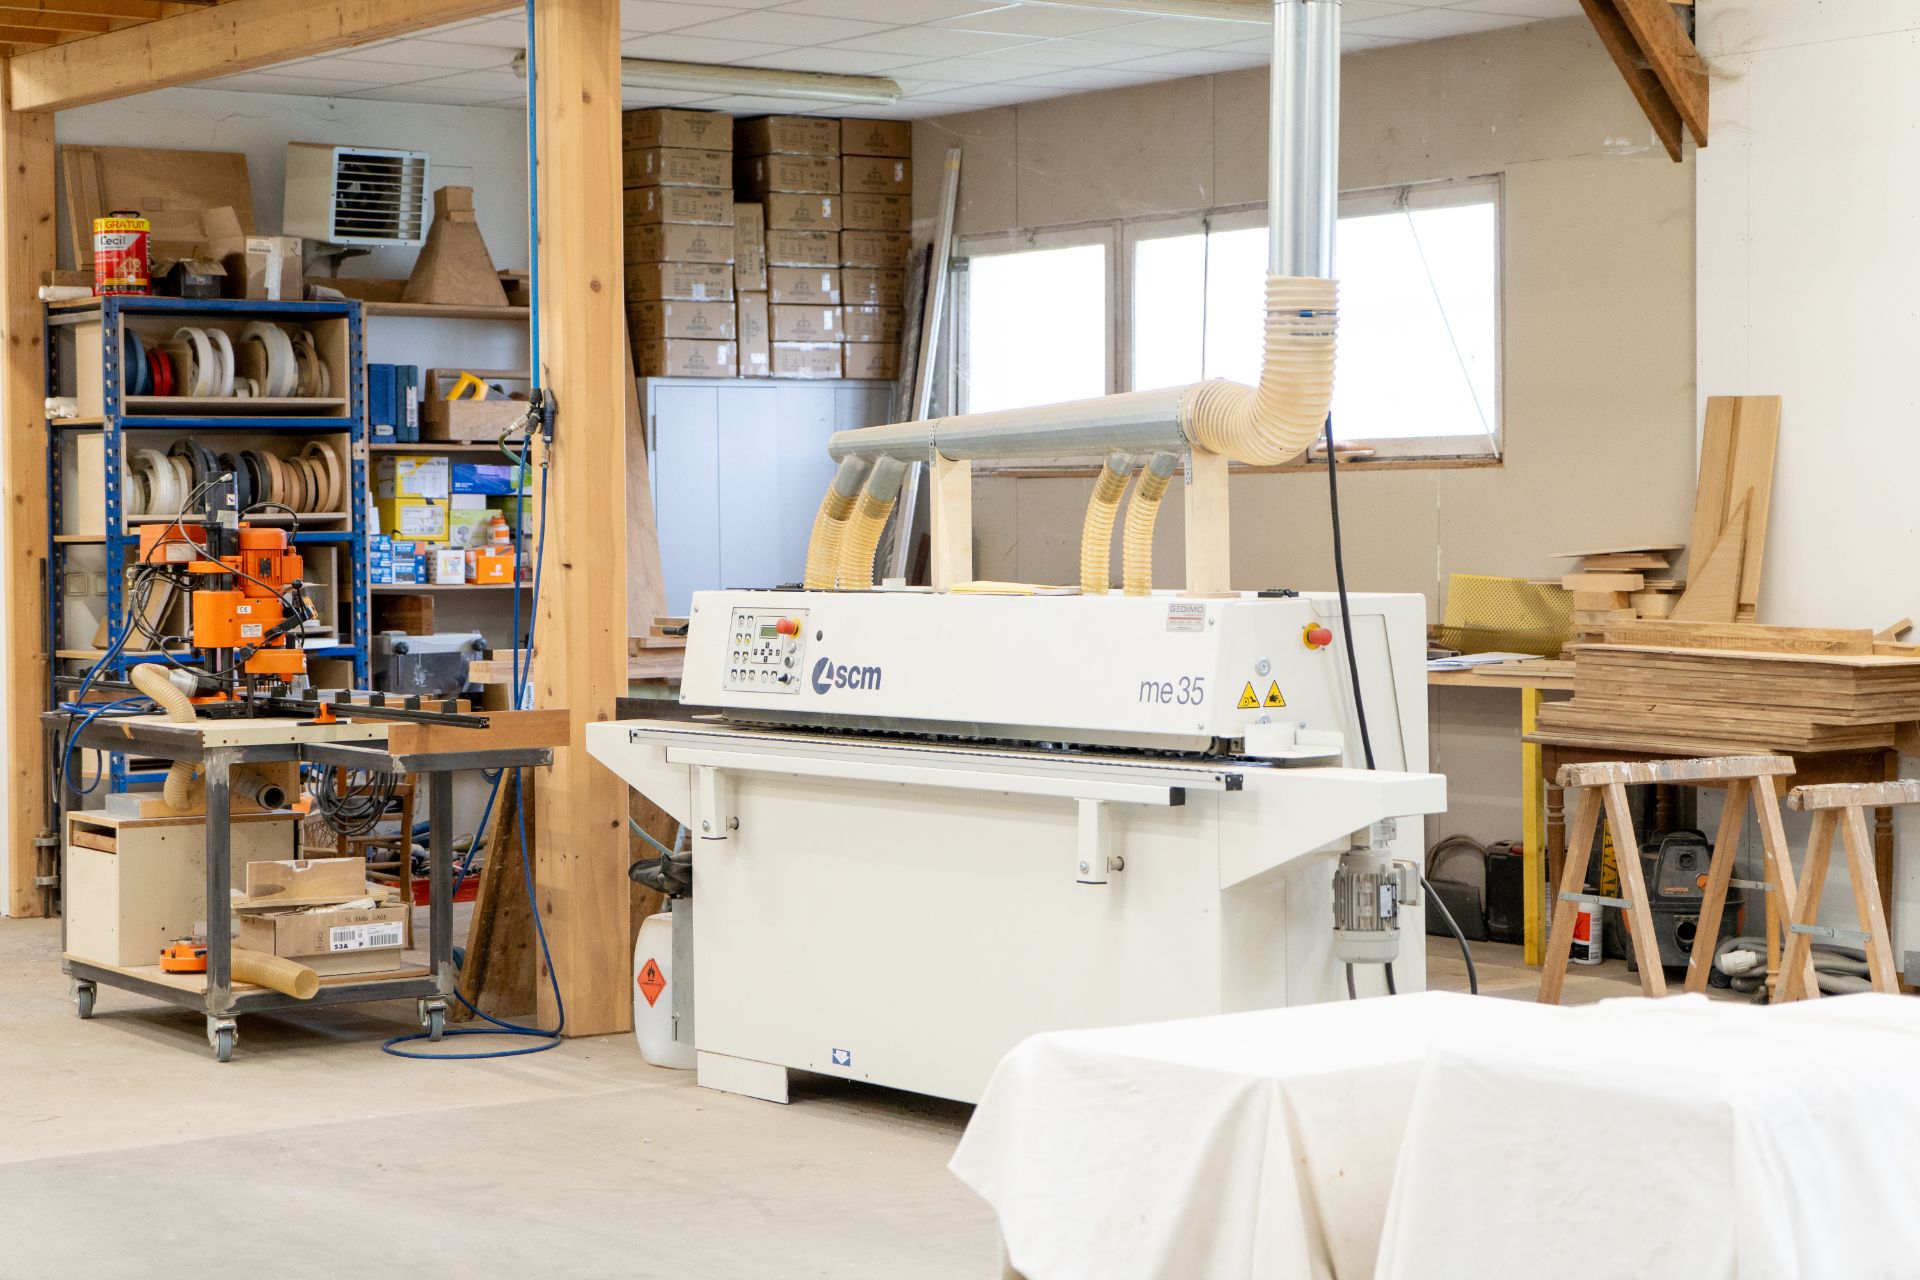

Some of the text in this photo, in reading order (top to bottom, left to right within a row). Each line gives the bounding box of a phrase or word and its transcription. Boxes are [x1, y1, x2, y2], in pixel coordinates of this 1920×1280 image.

[105, 219, 145, 230] GRATUIT
[101, 235, 126, 245] Cecil
[834, 665, 882, 690] scm
[1139, 676, 1205, 705] me 35
